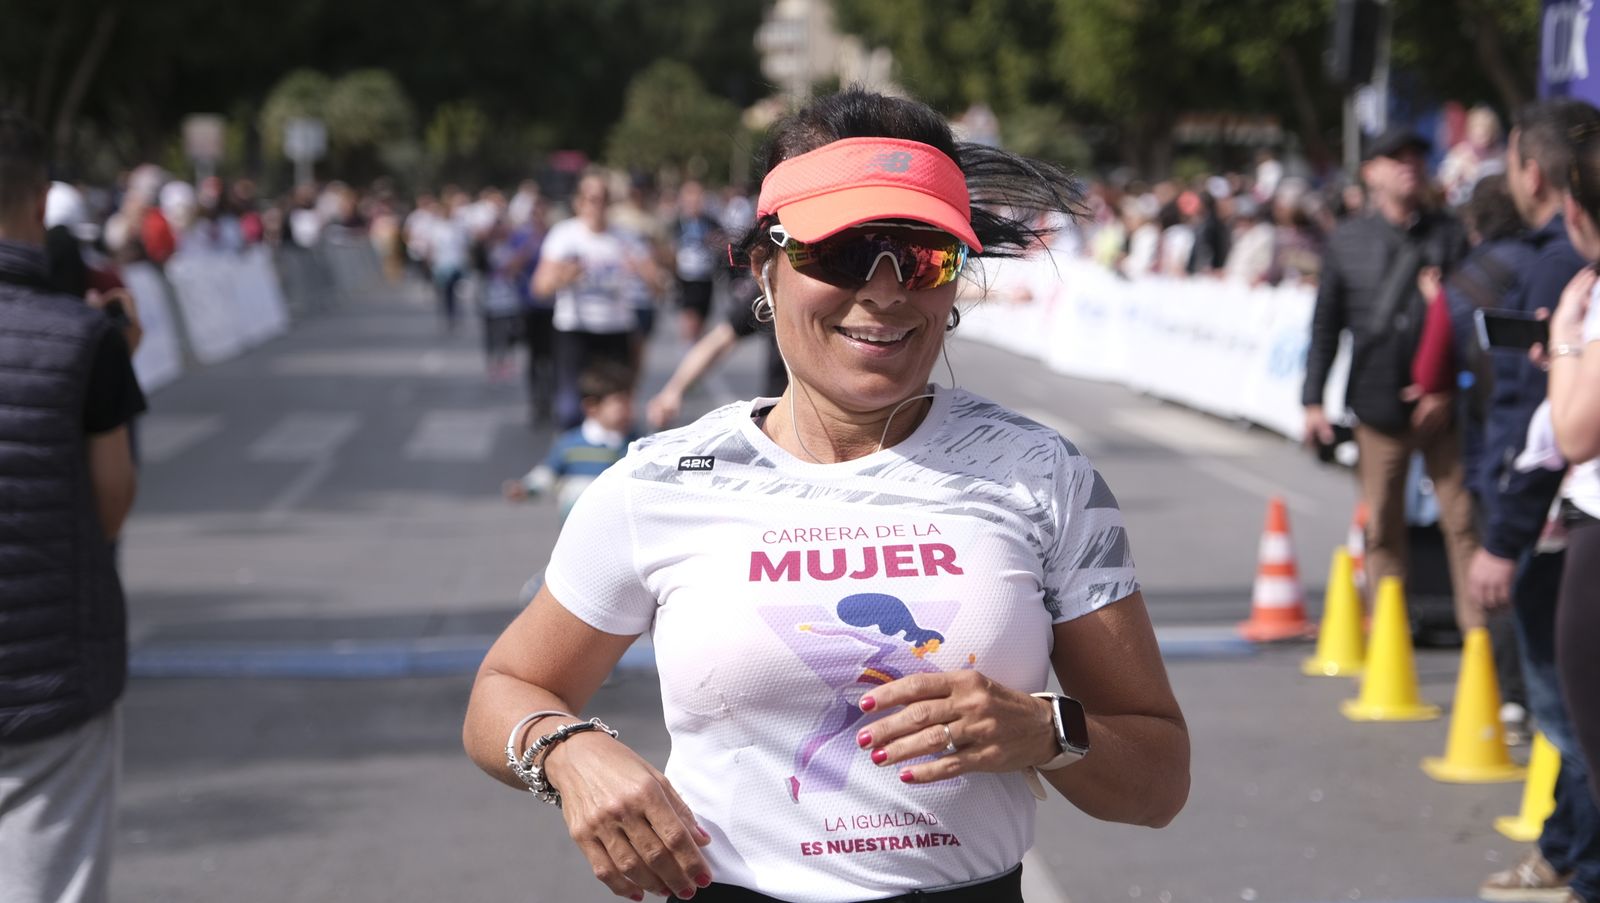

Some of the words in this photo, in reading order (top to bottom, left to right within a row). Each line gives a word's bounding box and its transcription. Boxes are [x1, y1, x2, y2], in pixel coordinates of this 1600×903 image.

[680, 458, 713, 469] 42K
[762, 527, 869, 544] CARRERA
[876, 524, 905, 538] DE
[912, 523, 941, 536] LA
[749, 543, 963, 582] MUJER
[825, 816, 847, 831] LA
[852, 812, 938, 829] IGUALDAD
[800, 841, 823, 856] ES
[827, 835, 913, 854] NUESTRA
[916, 832, 961, 848] META
